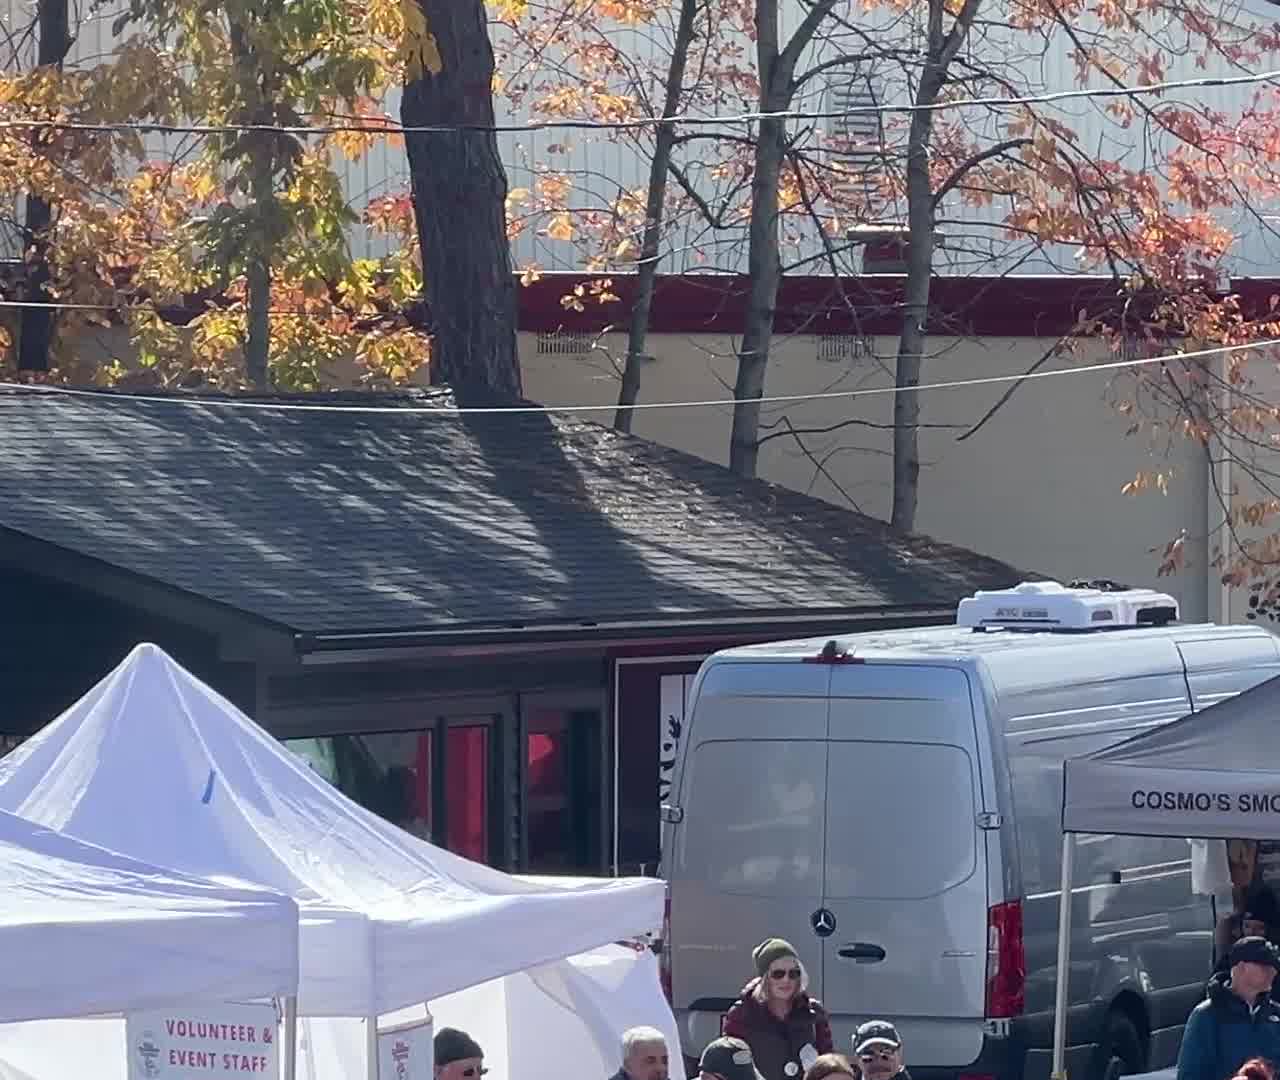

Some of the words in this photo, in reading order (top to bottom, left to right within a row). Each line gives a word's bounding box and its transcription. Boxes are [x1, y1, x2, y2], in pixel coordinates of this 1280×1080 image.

[1131, 789, 1231, 812] COSMO'S
[165, 1020, 256, 1043] VOLUNTEER
[263, 1028, 273, 1044] &
[169, 1049, 216, 1070] EVENT
[223, 1053, 269, 1073] STAFF
